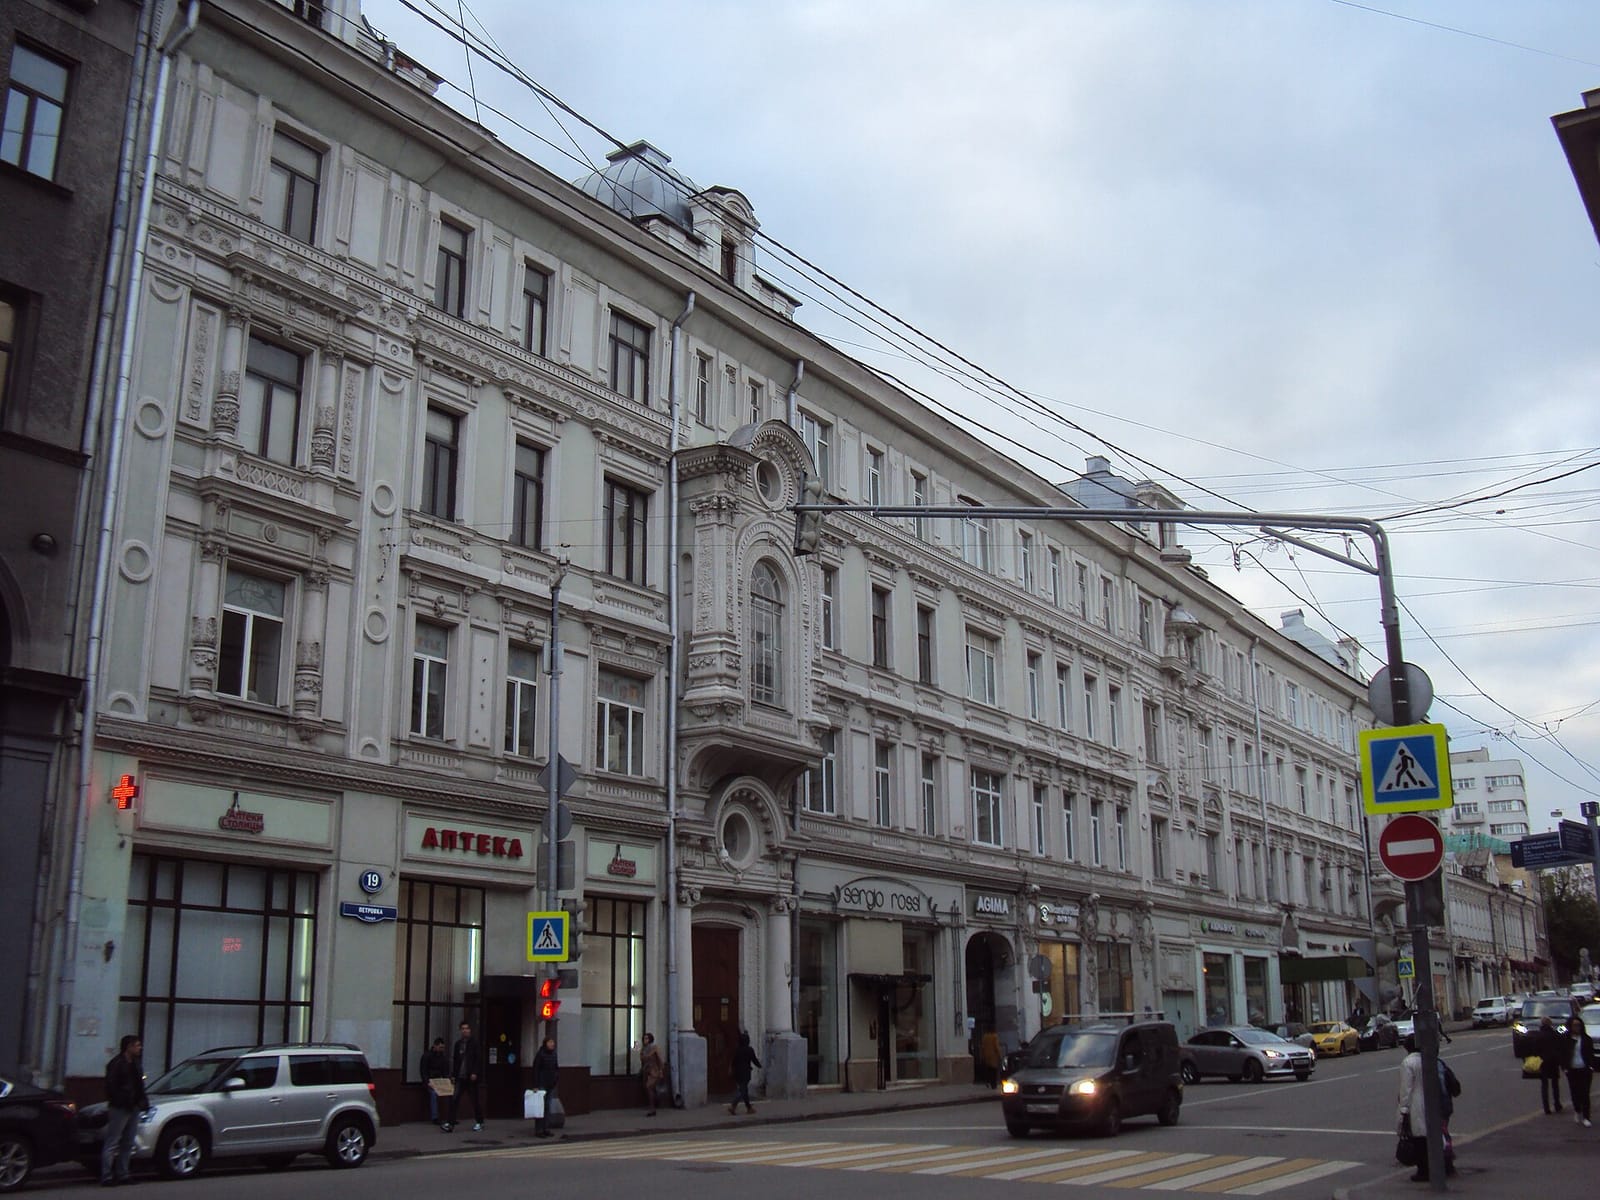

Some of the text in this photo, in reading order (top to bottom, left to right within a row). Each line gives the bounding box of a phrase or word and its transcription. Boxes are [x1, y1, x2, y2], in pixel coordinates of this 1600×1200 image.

[422, 827, 524, 858] АПТЕКА
[367, 873, 379, 887] 19
[843, 887, 921, 912] sergio rossi
[977, 895, 1009, 914] AGIMA
[543, 1003, 551, 1017] 6
